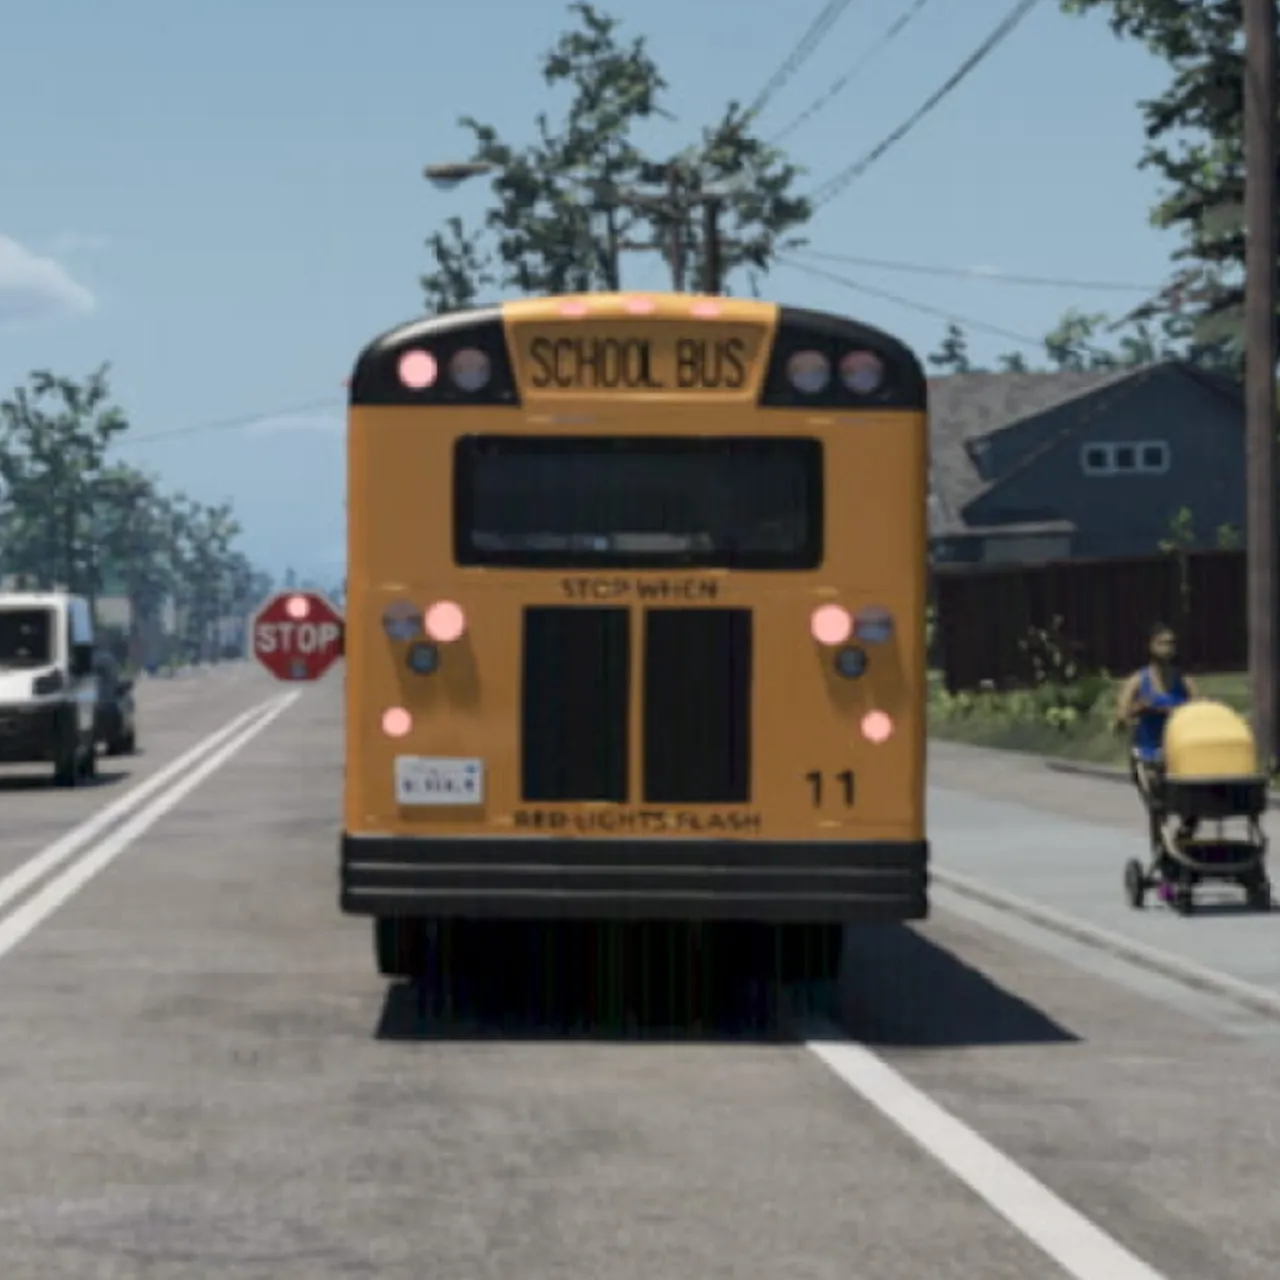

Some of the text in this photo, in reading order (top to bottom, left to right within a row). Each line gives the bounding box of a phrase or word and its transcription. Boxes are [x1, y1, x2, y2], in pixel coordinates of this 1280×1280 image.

[530, 336, 746, 388] SCHOOL BUS
[257, 622, 340, 654] STOP
[804, 768, 856, 810] 11
